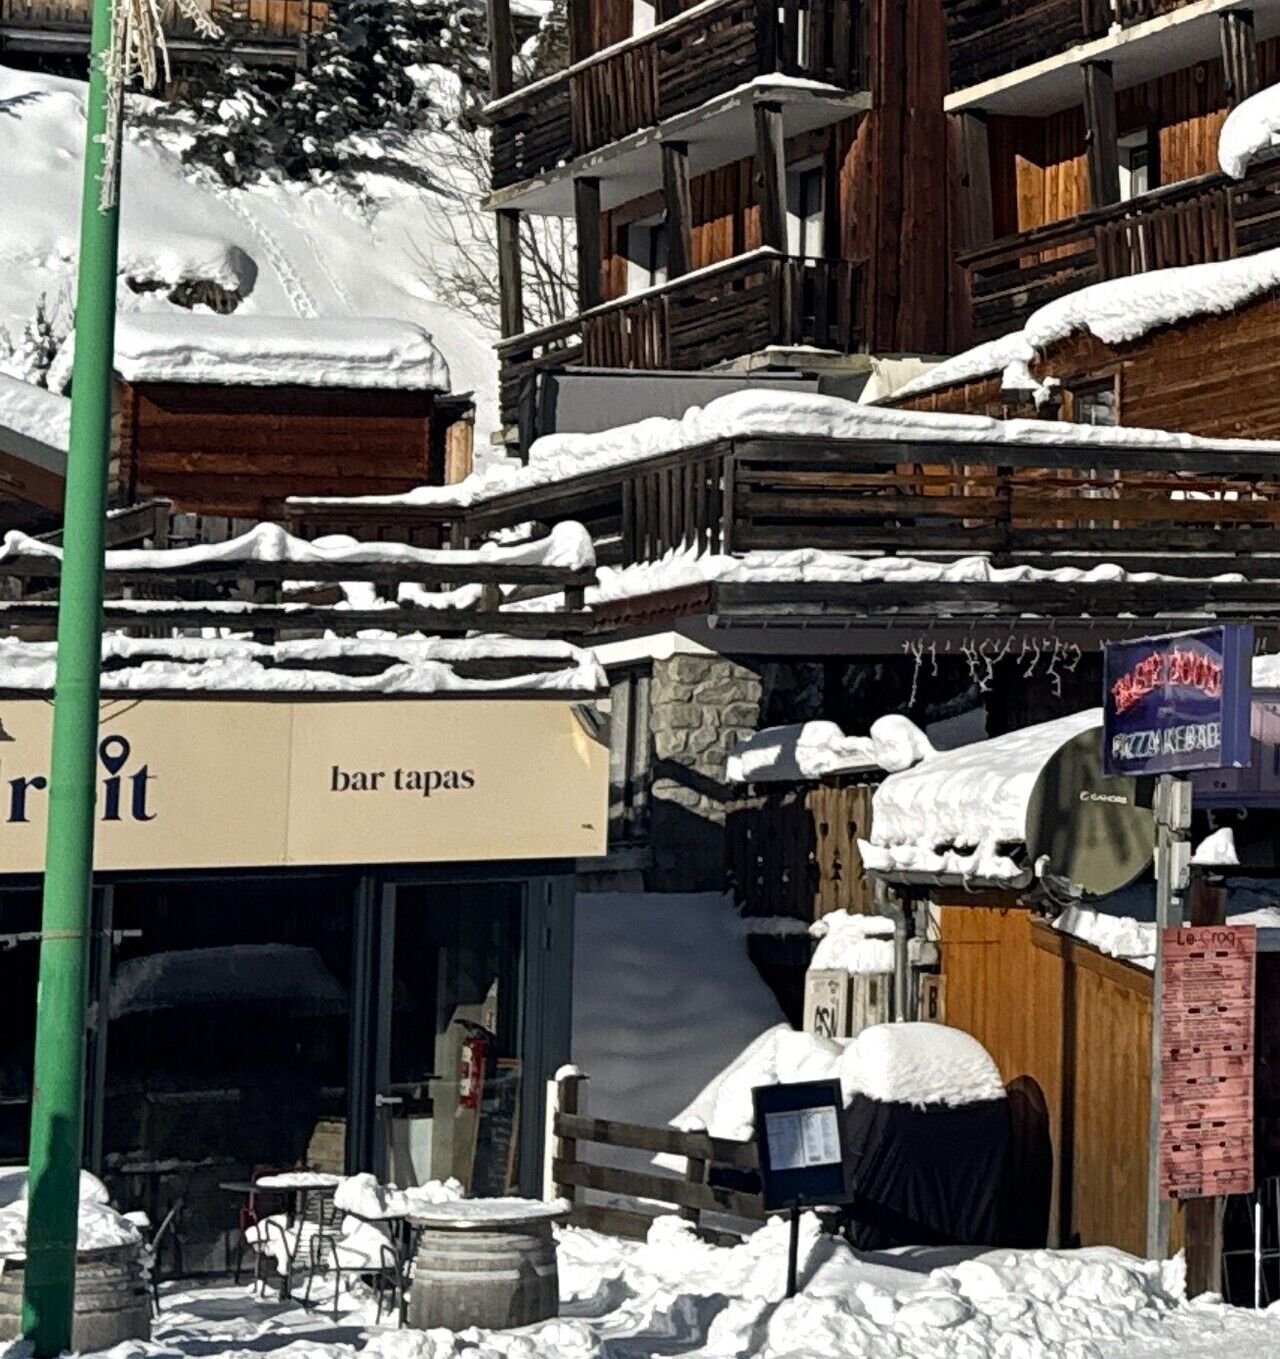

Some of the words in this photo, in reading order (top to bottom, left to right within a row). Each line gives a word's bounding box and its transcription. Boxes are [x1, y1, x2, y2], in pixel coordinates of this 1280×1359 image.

[0, 735, 158, 823] rit
[331, 766, 385, 791] bar
[394, 768, 475, 797] tapas
